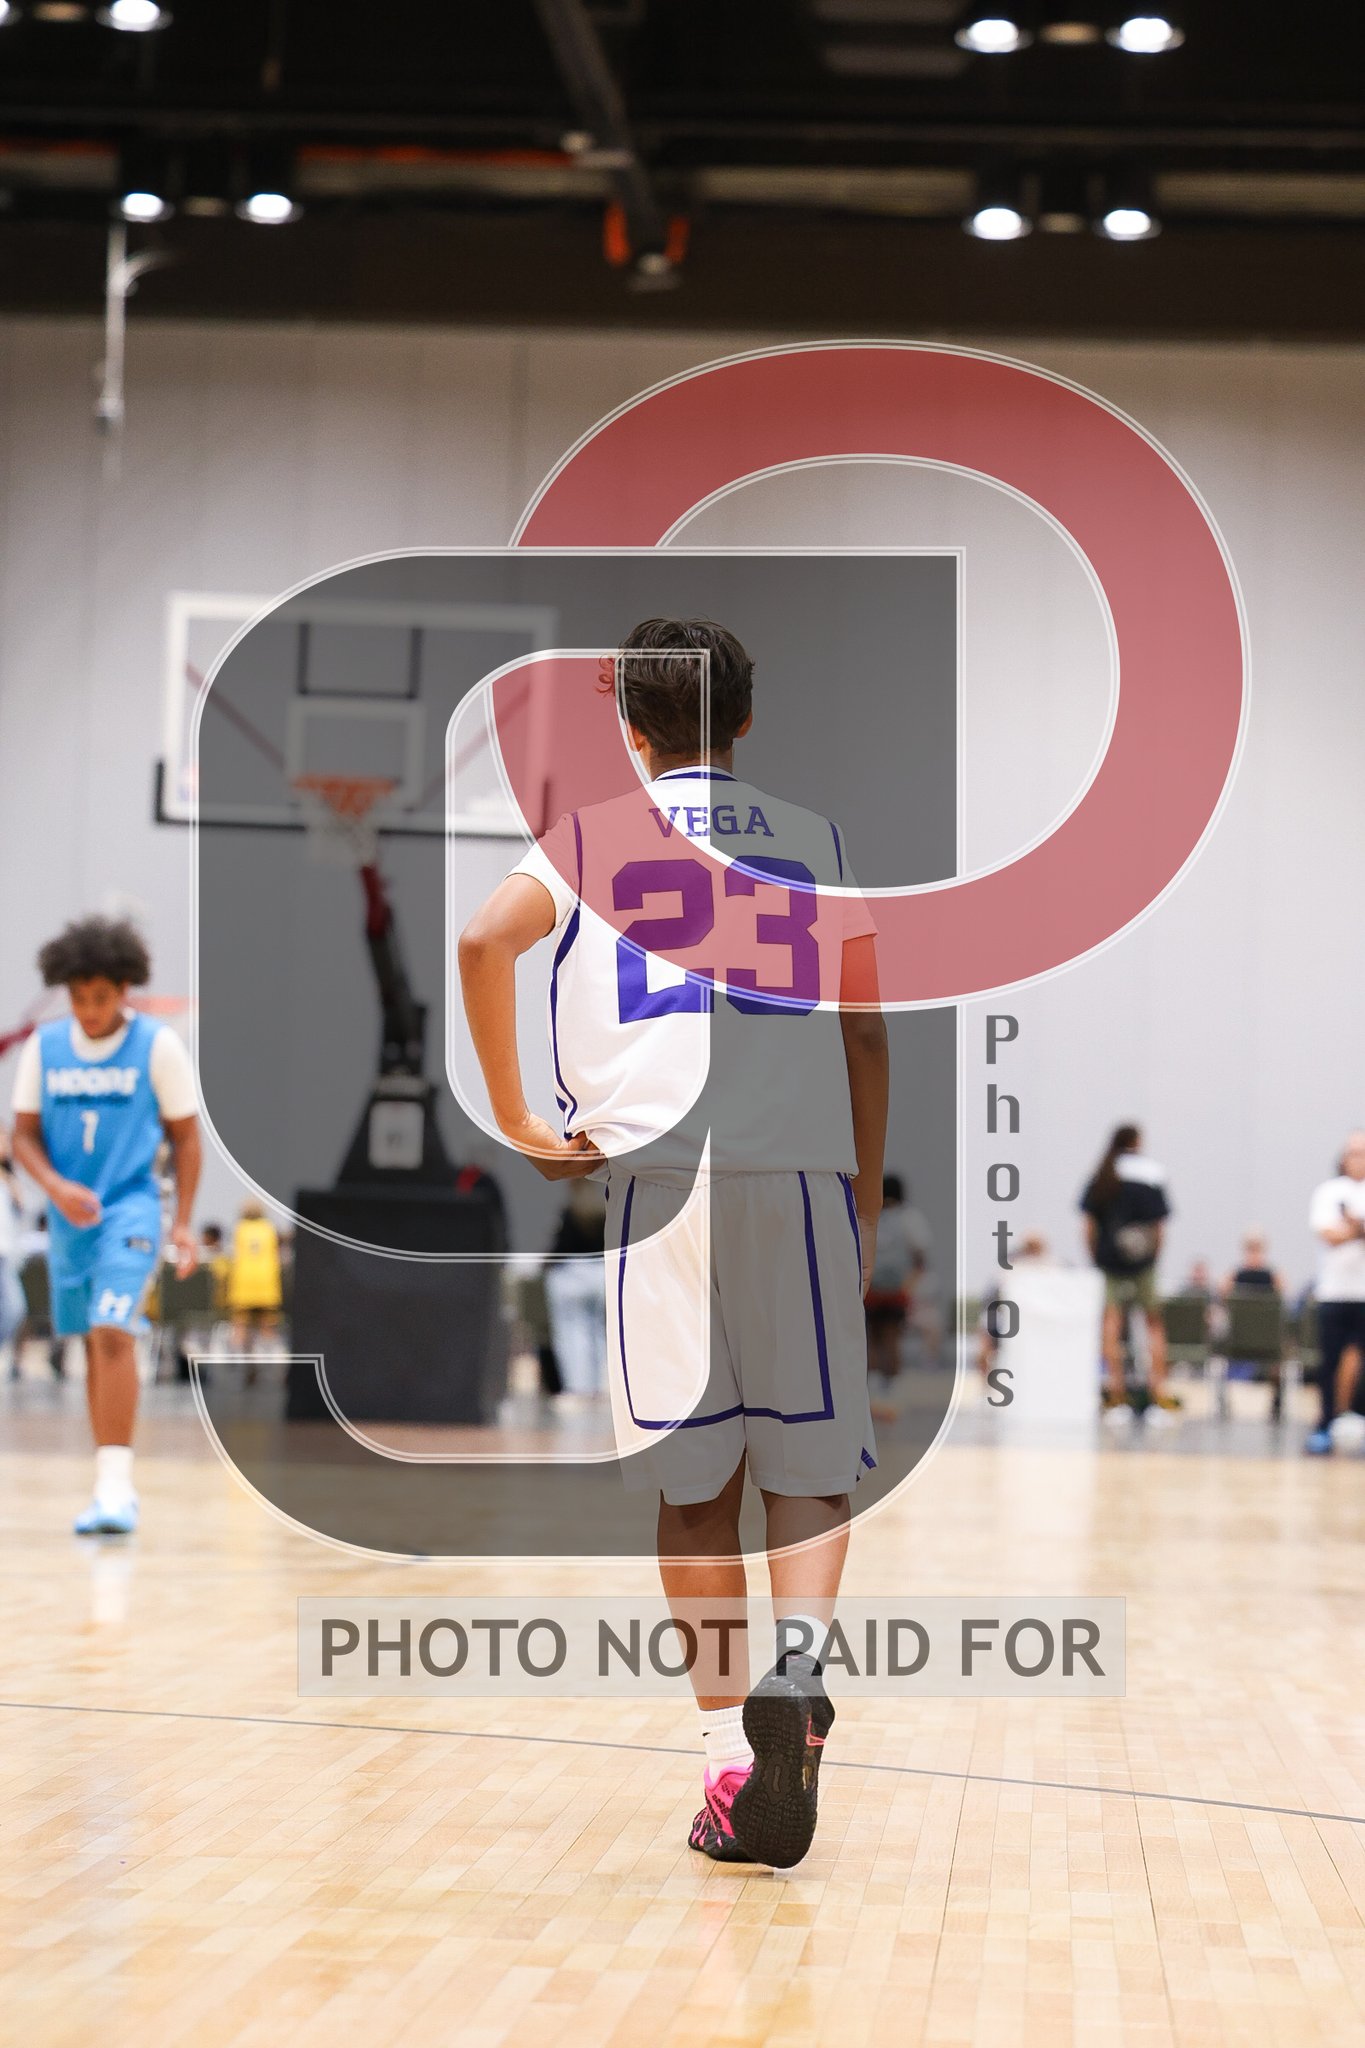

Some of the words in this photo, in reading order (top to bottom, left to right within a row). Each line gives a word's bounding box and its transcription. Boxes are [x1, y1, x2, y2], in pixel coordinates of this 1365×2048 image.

[649, 805, 774, 838] VEGA
[612, 856, 820, 1023] 23
[81, 1110, 99, 1155] 1
